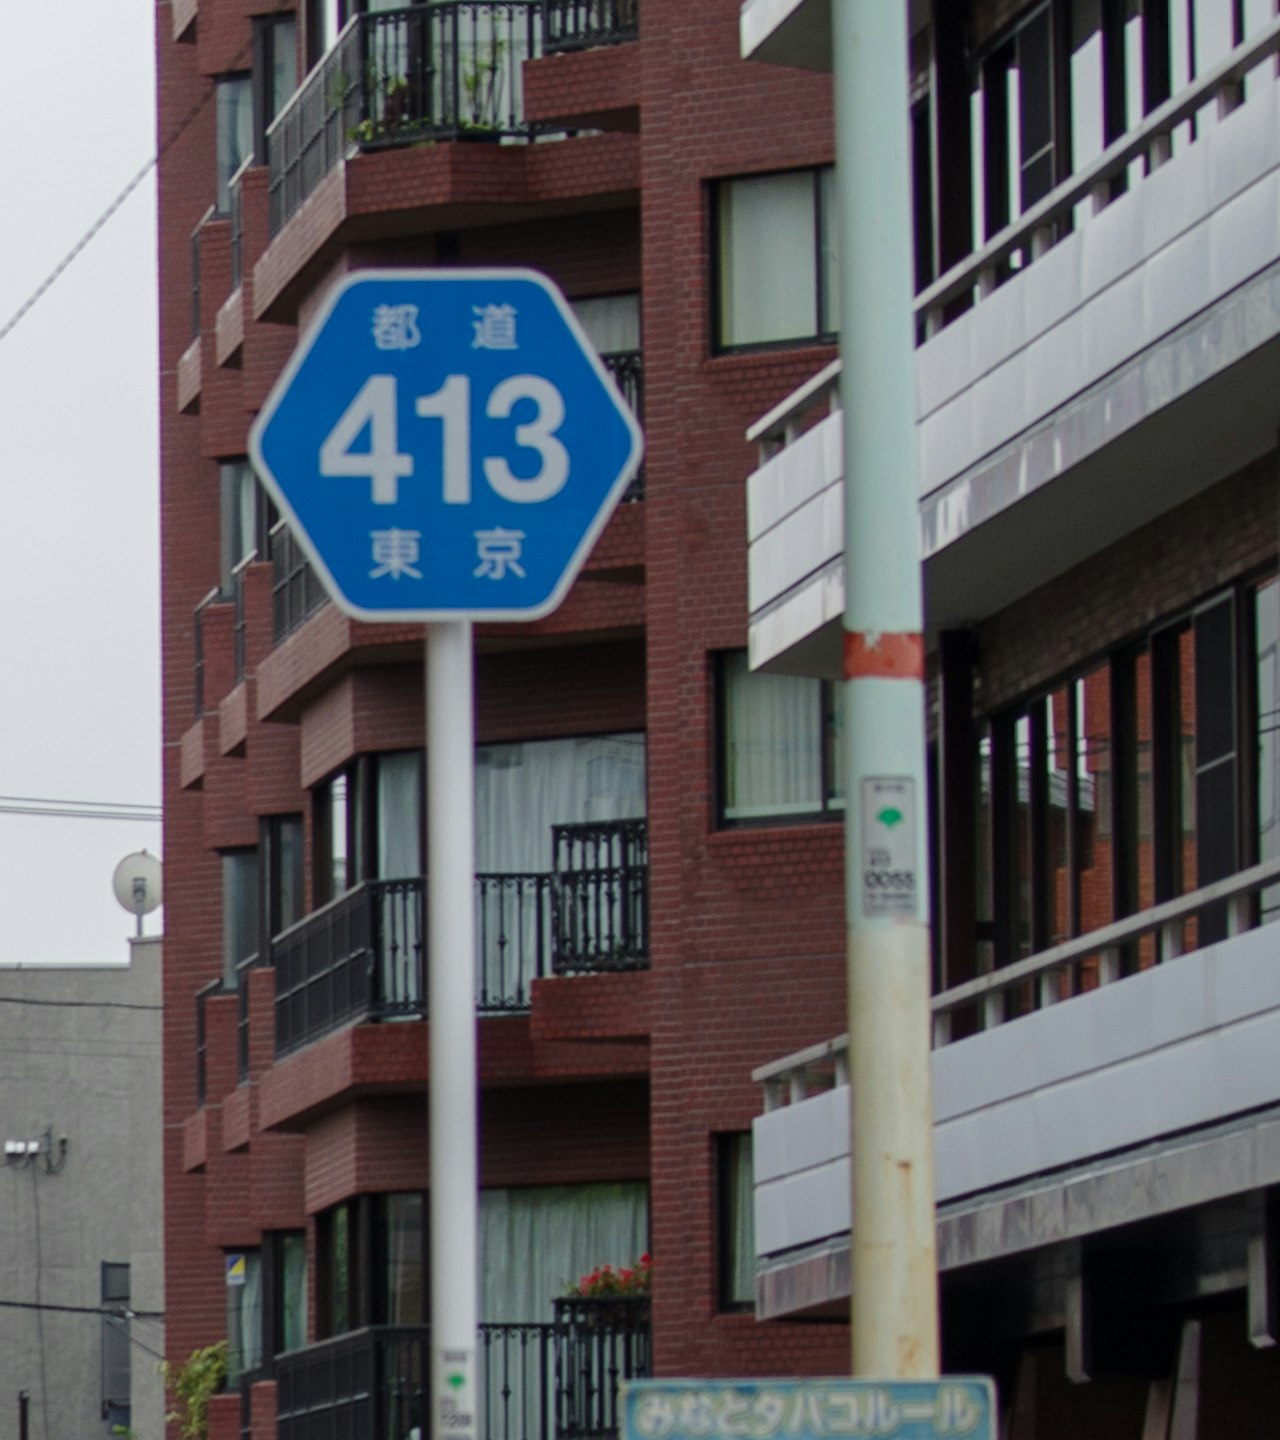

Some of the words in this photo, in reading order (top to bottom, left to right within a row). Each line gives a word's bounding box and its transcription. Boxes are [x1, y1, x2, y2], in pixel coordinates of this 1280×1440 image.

[371, 303, 519, 351] 都道
[318, 373, 571, 505] 413
[368, 527, 527, 581] 東京
[639, 1388, 980, 1436] みなとタバコルール
